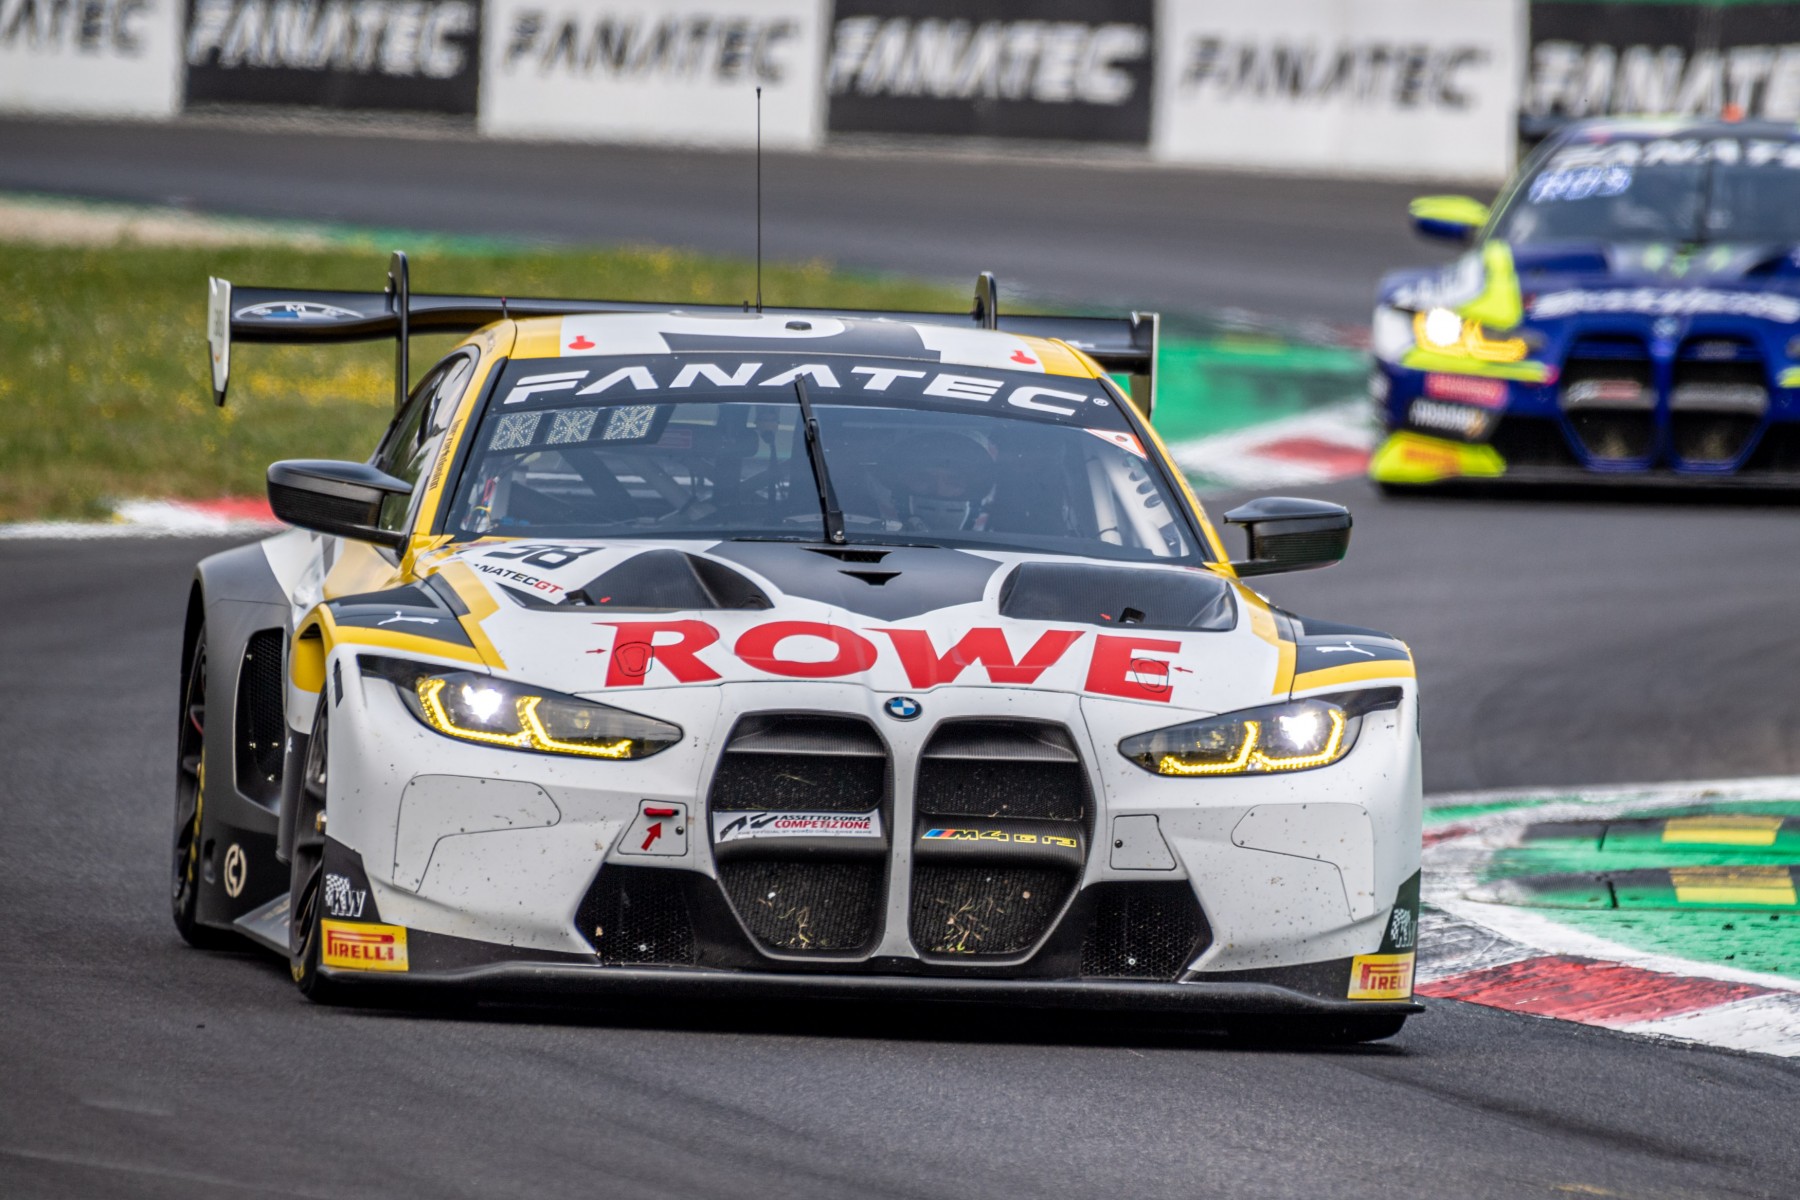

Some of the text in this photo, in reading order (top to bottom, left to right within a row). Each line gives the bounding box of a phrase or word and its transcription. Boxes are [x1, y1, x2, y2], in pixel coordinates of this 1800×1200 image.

[186, 0, 475, 78] FANATEC
[500, 10, 798, 86] FANATEC
[827, 16, 1150, 105] FANATEC
[1181, 35, 1490, 111] FANATEC
[592, 619, 1182, 703] ROWE
[779, 814, 830, 822] ASSETTO
[953, 829, 1009, 842] M4
[328, 882, 367, 917] KW
[327, 929, 395, 961] PIRELLI
